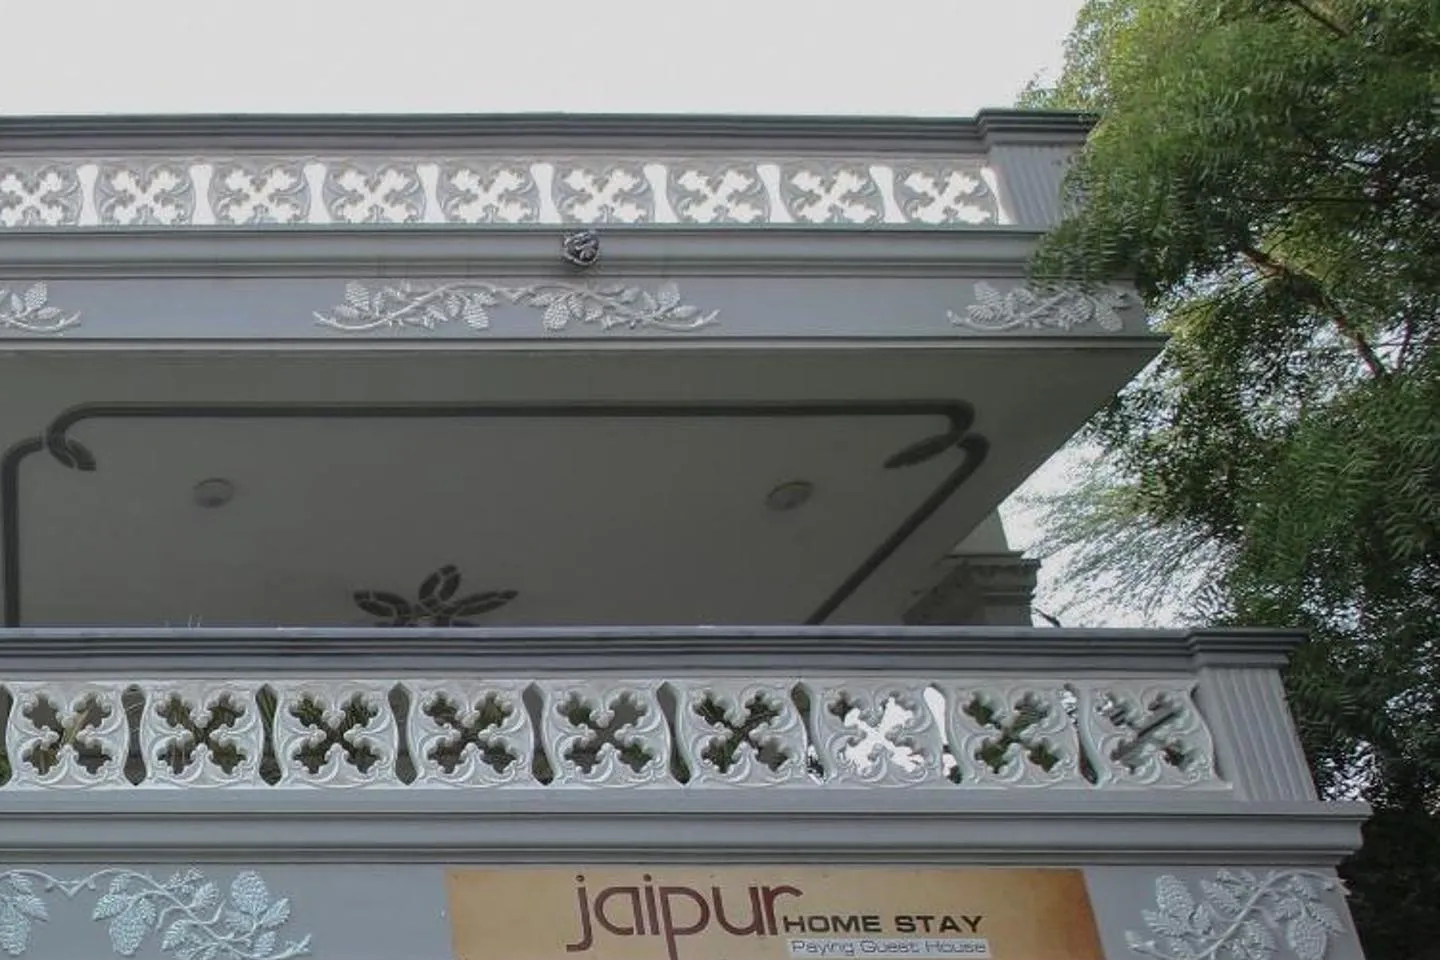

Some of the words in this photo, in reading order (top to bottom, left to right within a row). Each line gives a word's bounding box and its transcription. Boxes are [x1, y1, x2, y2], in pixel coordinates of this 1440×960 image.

[783, 915, 883, 933] HOME
[894, 915, 983, 933] STAY
[791, 940, 855, 956] Paying
[859, 940, 920, 953] Guest
[925, 940, 987, 953] House
